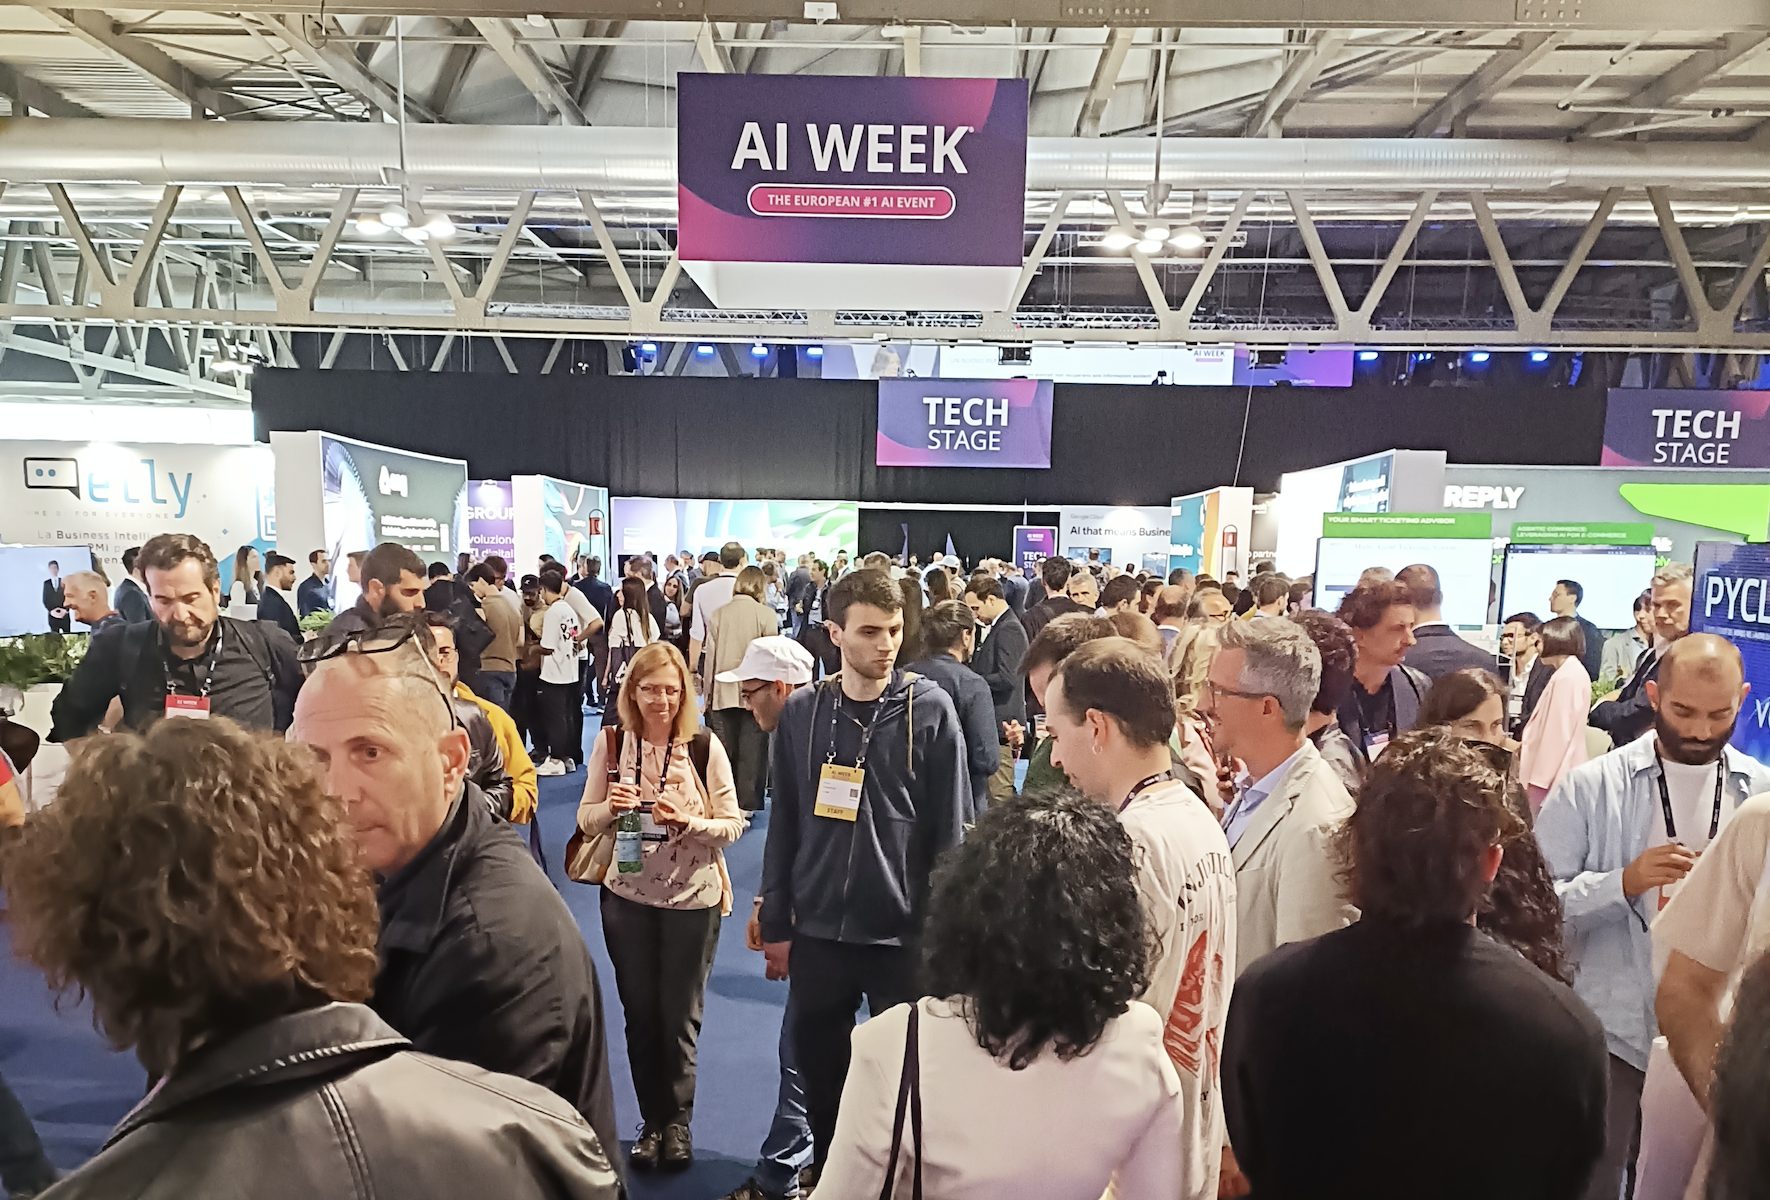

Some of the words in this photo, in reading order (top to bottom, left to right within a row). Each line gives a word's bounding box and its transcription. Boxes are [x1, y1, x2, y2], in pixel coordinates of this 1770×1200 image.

[731, 122, 787, 170] AI
[806, 123, 968, 174] WEEK
[768, 194, 790, 206] THE
[794, 195, 860, 207] EUROPEAN
[863, 196, 878, 208] #1
[881, 197, 894, 208] AI
[897, 197, 936, 209] EVENT
[923, 397, 1009, 427] TECH
[1652, 409, 1742, 439] TECH
[927, 430, 1001, 451] STAGE
[1653, 442, 1731, 464] STAGE
[1443, 485, 1525, 509] REPLY
[56, 530, 110, 541] Business
[1070, 526, 1081, 535] AI
[1083, 526, 1102, 536] that
